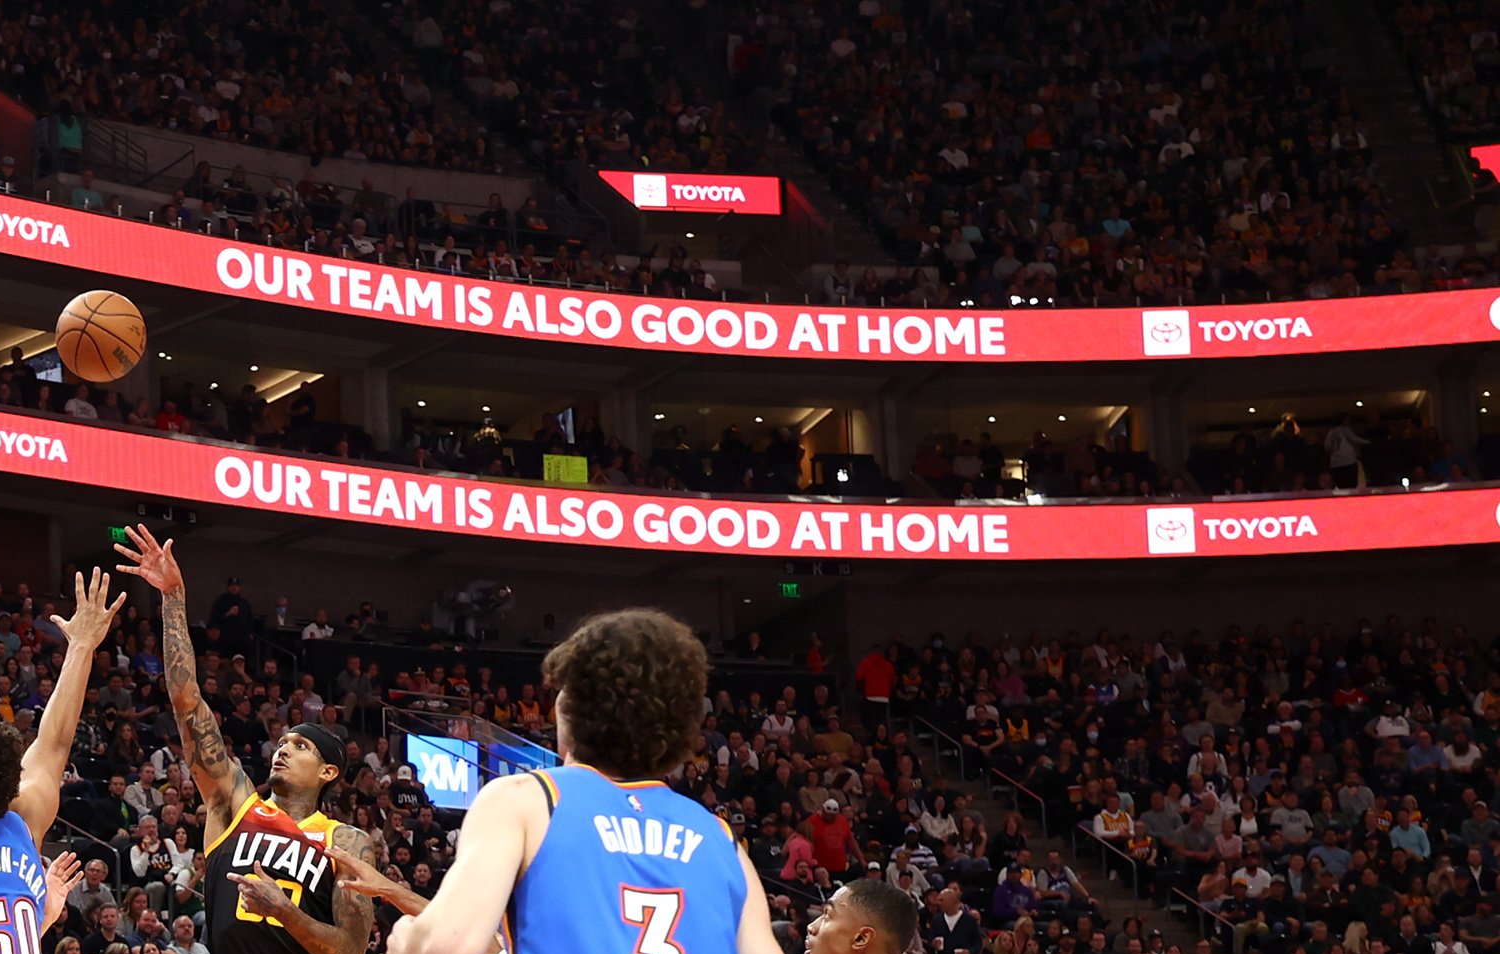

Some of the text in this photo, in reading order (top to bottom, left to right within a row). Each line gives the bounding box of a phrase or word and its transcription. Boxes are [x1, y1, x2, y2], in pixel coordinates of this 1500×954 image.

[672, 184, 746, 203] TOYOTA
[215, 247, 1007, 356] OUR TEAM IS ALSO GOOD AT HOME
[1198, 317, 1313, 342] TOYOTA
[214, 455, 1009, 554] OUR TEAM IS ALSO GOOD AT HOME
[1203, 515, 1318, 540] TOYOTA
[812, 562, 823, 575] K
[419, 752, 468, 792] XM
[593, 814, 704, 864] GIDDEY
[231, 832, 329, 893] UTAH
